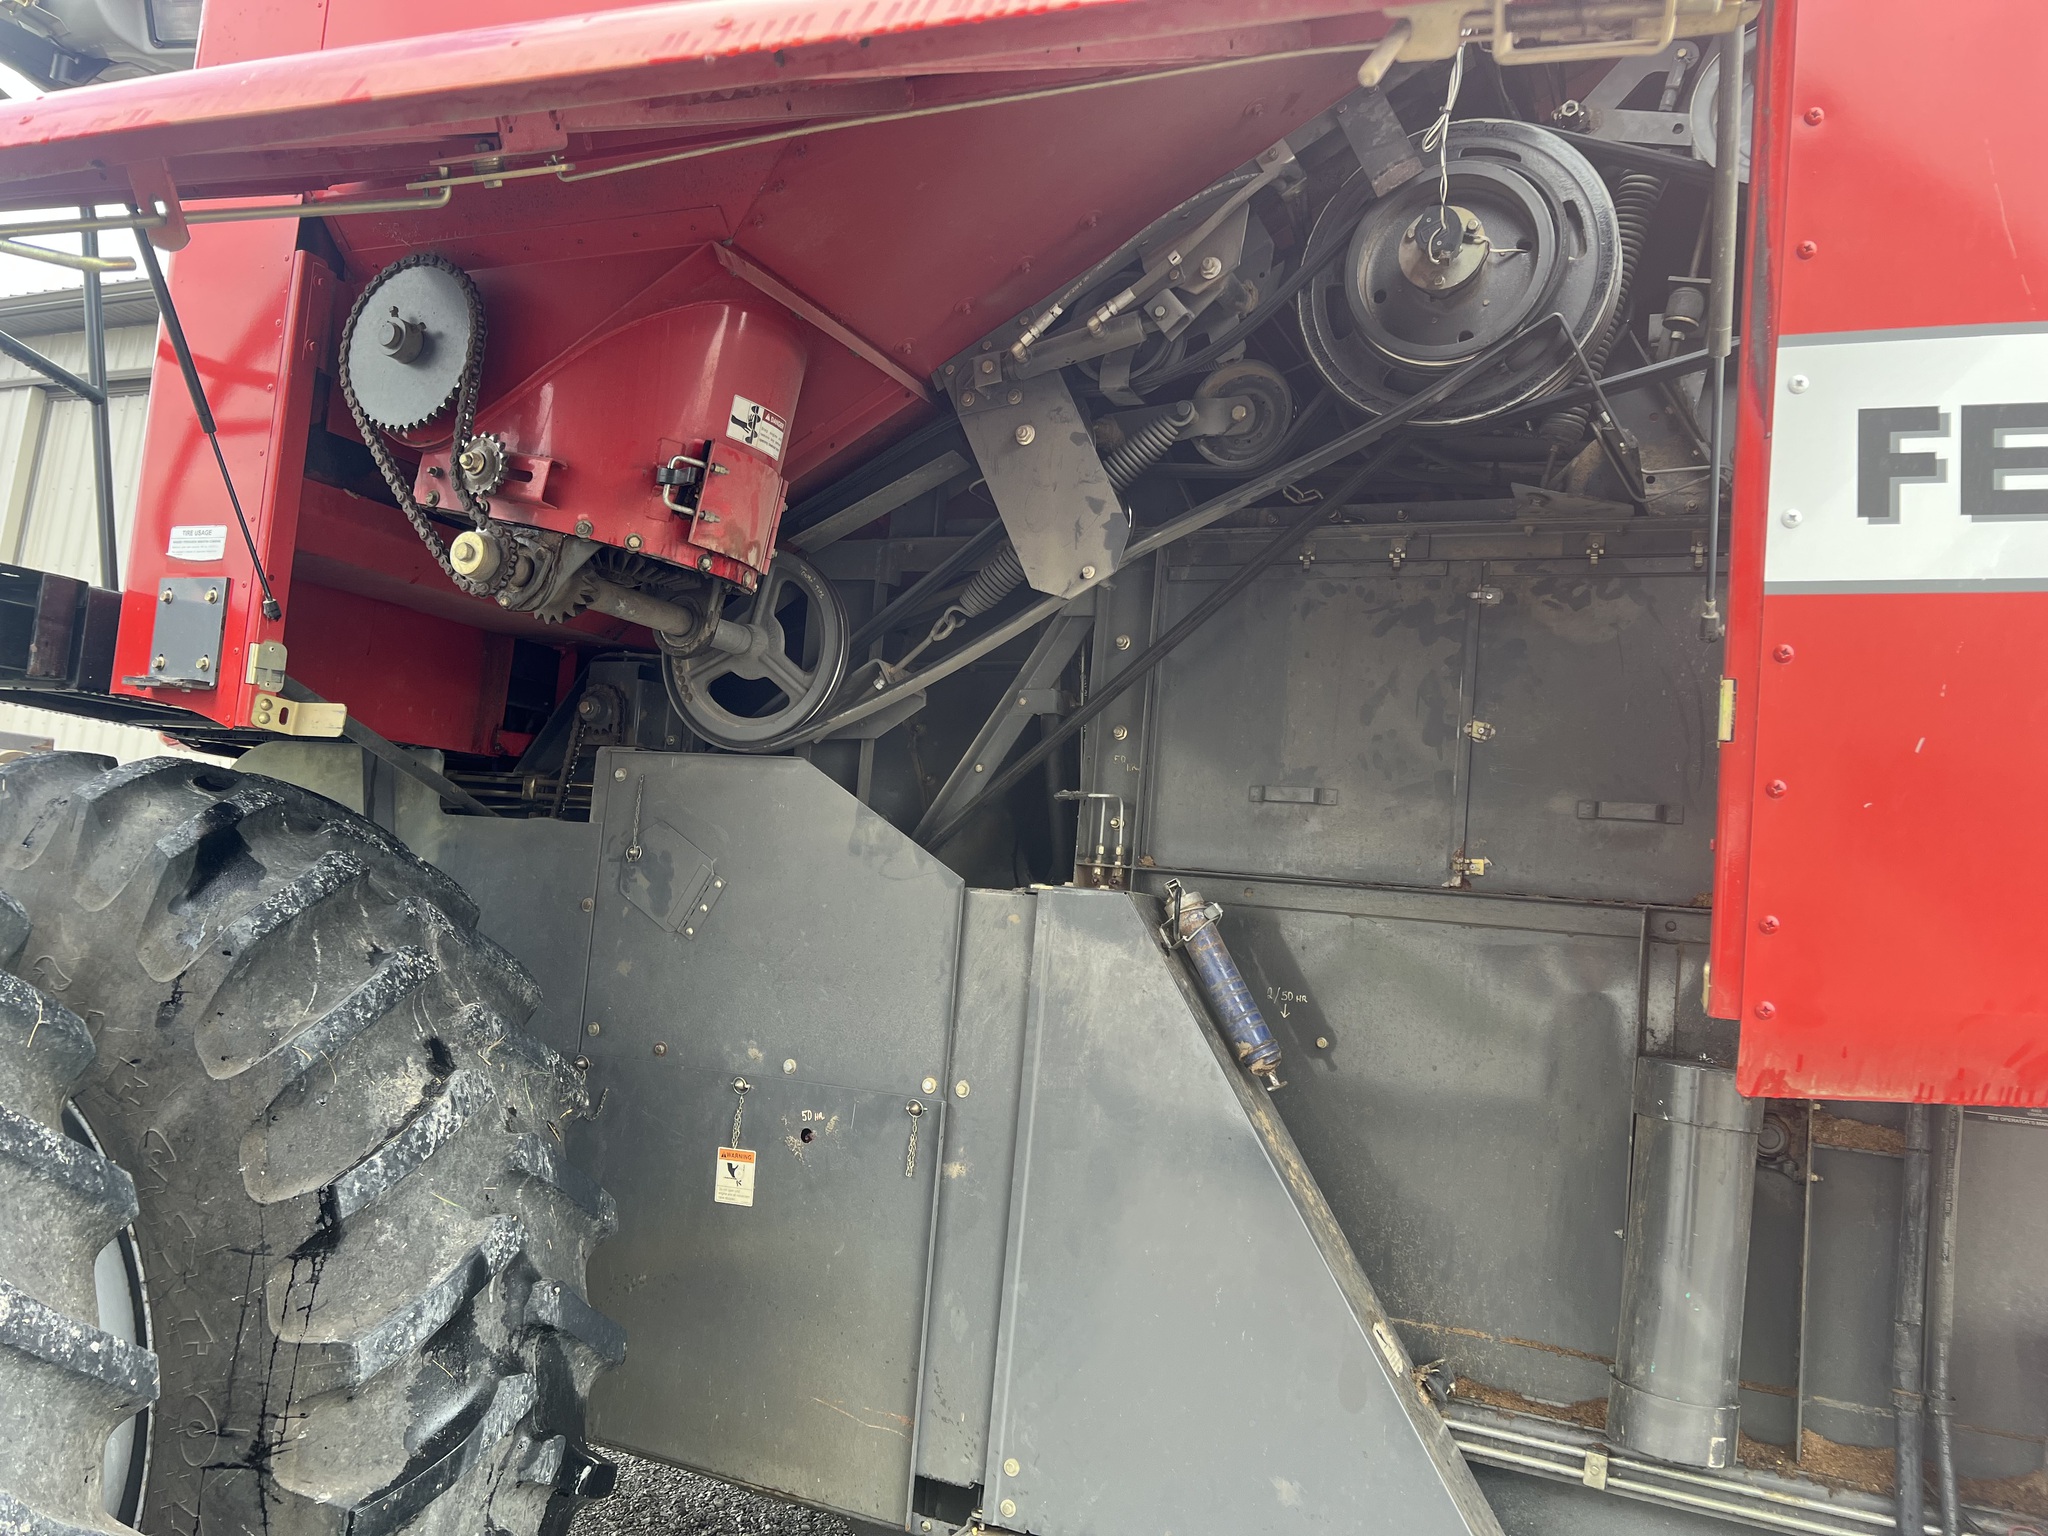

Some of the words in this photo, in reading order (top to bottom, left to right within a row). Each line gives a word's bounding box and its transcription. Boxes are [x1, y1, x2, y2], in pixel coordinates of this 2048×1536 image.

[1858, 402, 2048, 525] FE
[1295, 994, 1308, 1003] HR
[801, 1109, 812, 1122] 50
[726, 1152, 752, 1161] WARNING
